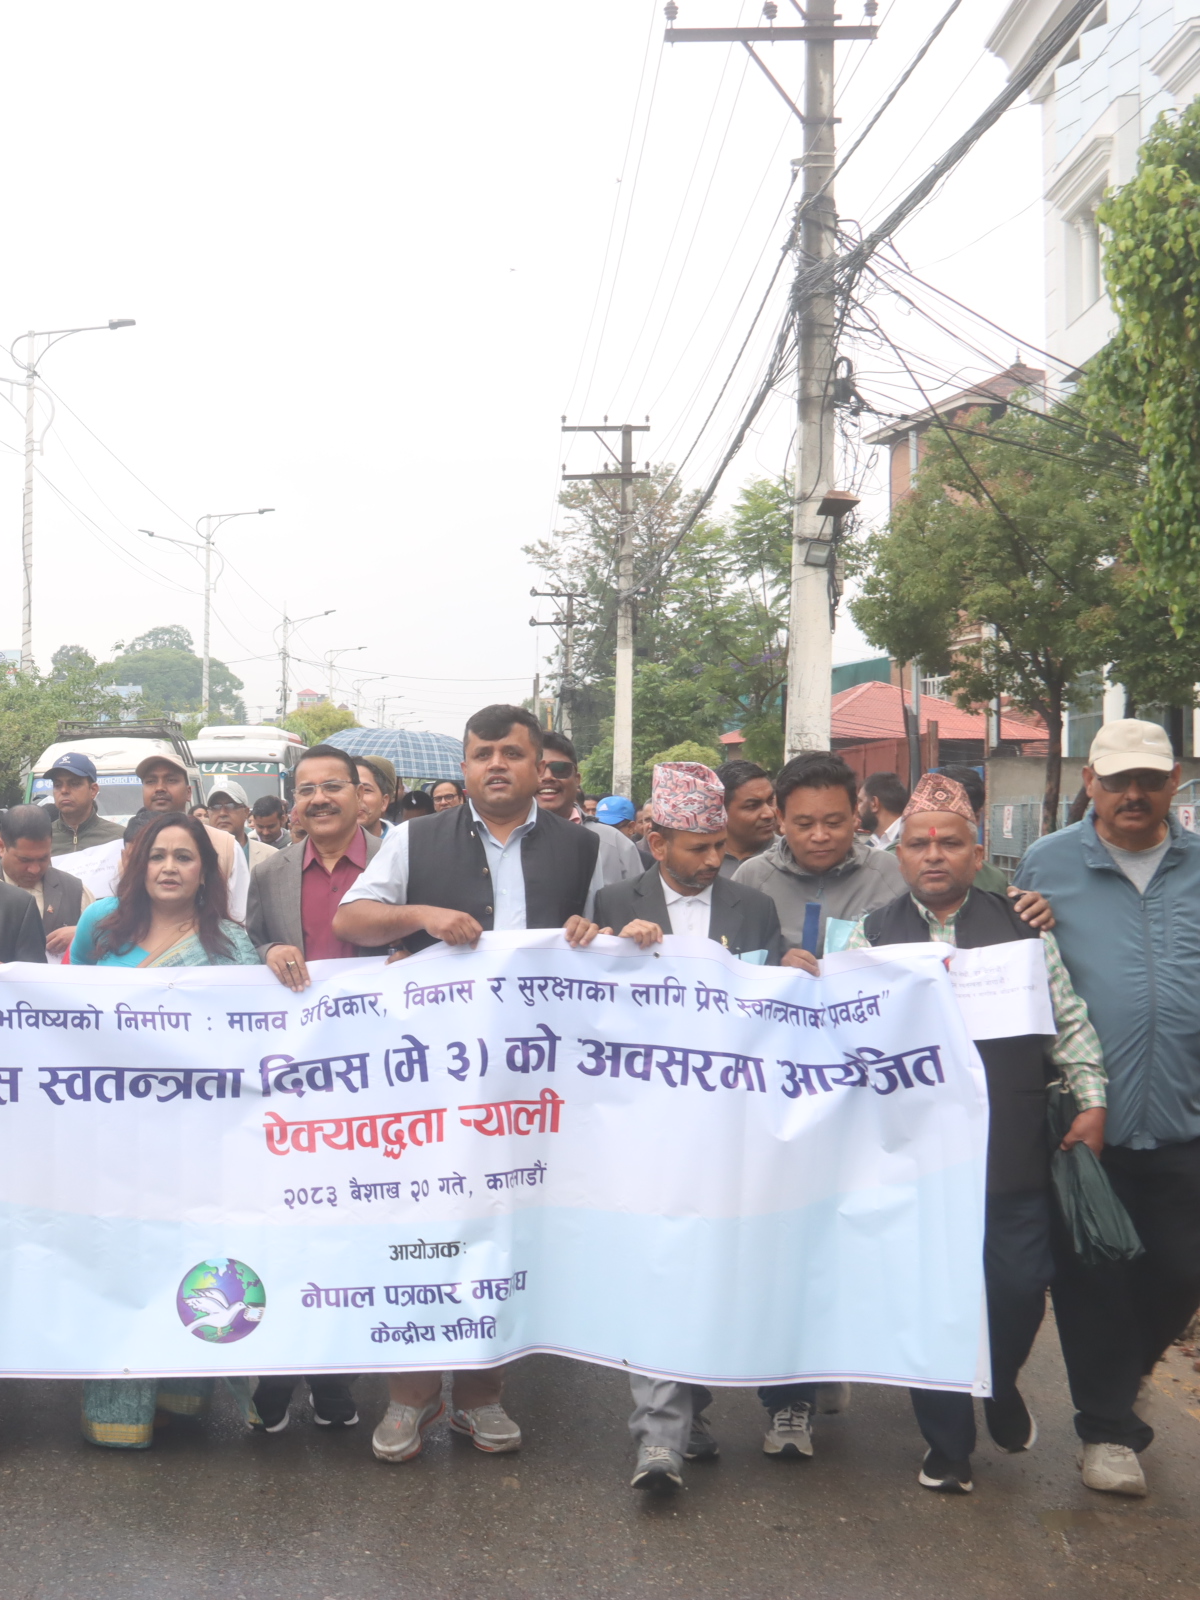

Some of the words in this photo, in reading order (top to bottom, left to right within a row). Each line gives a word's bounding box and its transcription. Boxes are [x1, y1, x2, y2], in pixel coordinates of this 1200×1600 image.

[201, 761, 275, 774] URIST
[114, 1003, 192, 1031] निर्माण
[226, 1011, 288, 1032] मानव
[404, 980, 475, 1009] विकास
[487, 977, 506, 1003] र
[517, 976, 619, 1007] सुरक्षाका
[630, 976, 687, 1007] लागि
[694, 981, 729, 1014] प्रेस
[38, 1065, 245, 1106] स्वतन्त्रता
[258, 1052, 370, 1100] दिवस
[505, 1023, 562, 1074] को
[577, 1038, 766, 1093] अवसरमा
[284, 1186, 337, 1209] २०८३
[349, 1177, 401, 1203] बैशाख
[411, 1179, 429, 1202] २०
[438, 1172, 472, 1198] गते,
[301, 1282, 376, 1308] नेपाल
[383, 1283, 462, 1307] पत्रकार
[370, 1321, 435, 1345] केन्द्रीय
